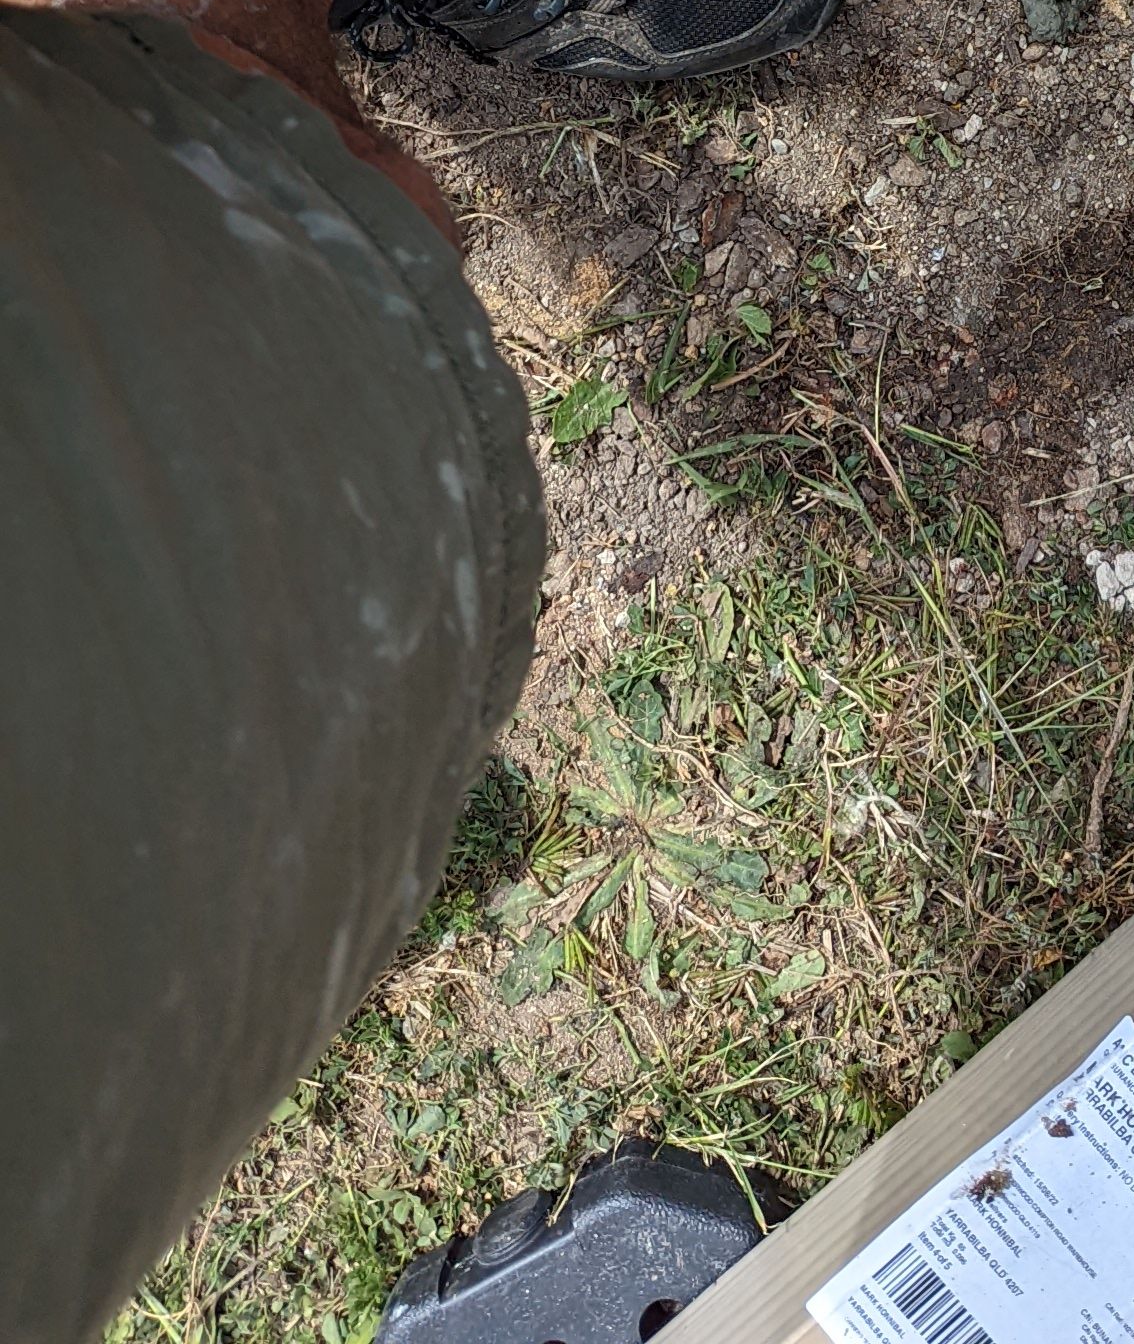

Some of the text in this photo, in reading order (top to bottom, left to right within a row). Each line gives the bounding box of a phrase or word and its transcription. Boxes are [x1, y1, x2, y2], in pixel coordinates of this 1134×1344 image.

[1077, 1122, 1121, 1173] Instructions:
[1118, 1169, 1134, 1186] NO
[1033, 1178, 1059, 1207] 15/08/22
[917, 1230, 953, 1271] Item 4 of 5
[945, 1208, 1025, 1297] YARRABILBA QLD 4207
[984, 1214, 1023, 1259] HONNIBAL
[847, 1295, 884, 1339] YARRABILBA
[859, 1284, 906, 1340] MARK HONNIBAL
